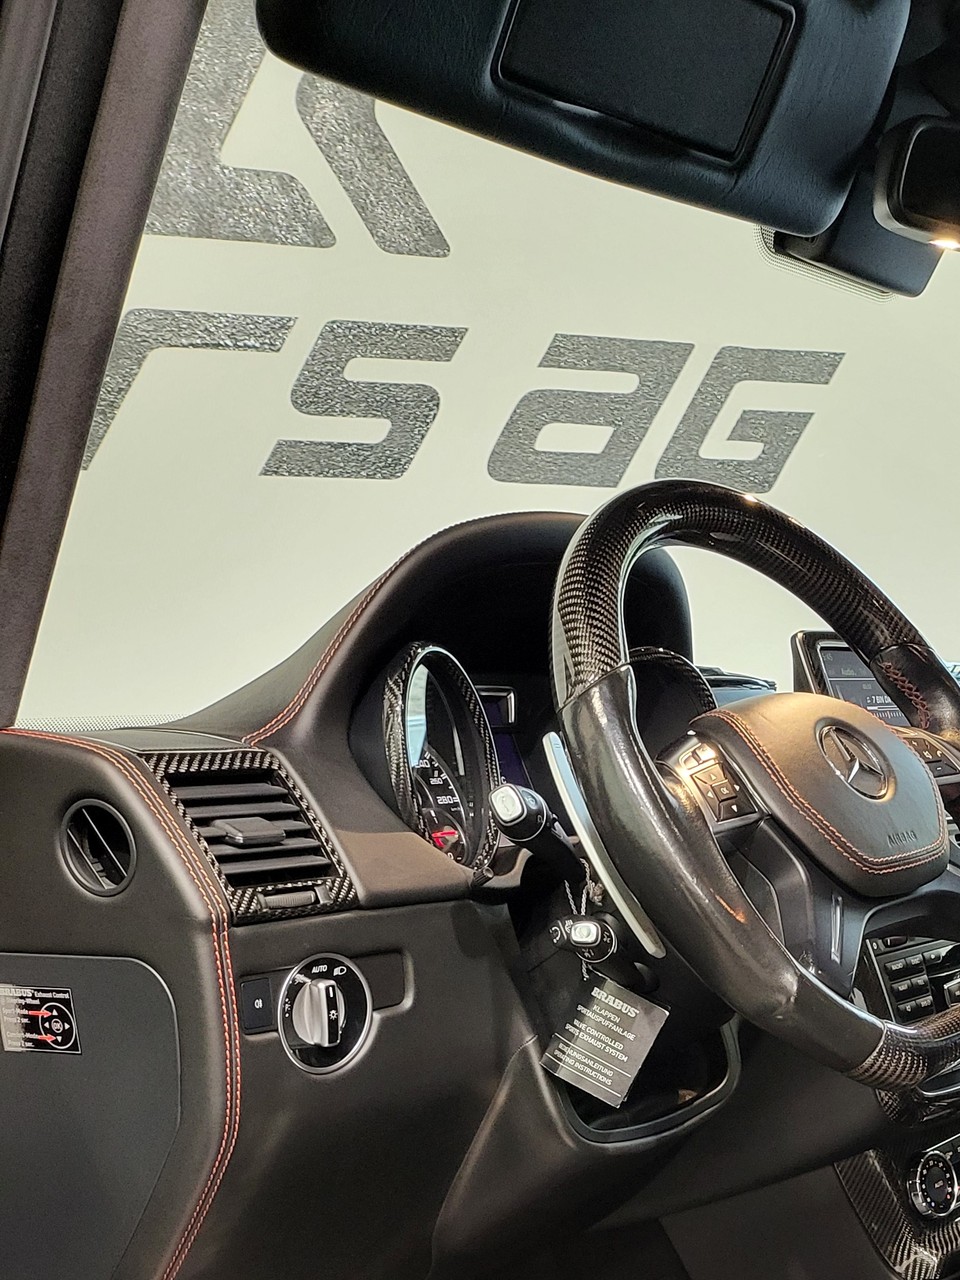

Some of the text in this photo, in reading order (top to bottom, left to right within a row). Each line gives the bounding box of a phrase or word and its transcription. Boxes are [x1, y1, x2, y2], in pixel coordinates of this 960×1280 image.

[436, 795, 454, 805] 280
[311, 964, 328, 974] AUTO
[590, 986, 640, 1018] BRABUS
[592, 1004, 621, 1023] KLAPPEN
[579, 1031, 606, 1051] EXHAUST
[604, 1044, 629, 1063] SYSTEM
[586, 1025, 624, 1051] CONTROLLED
[574, 1059, 613, 1086] INSTRUCTIONS
